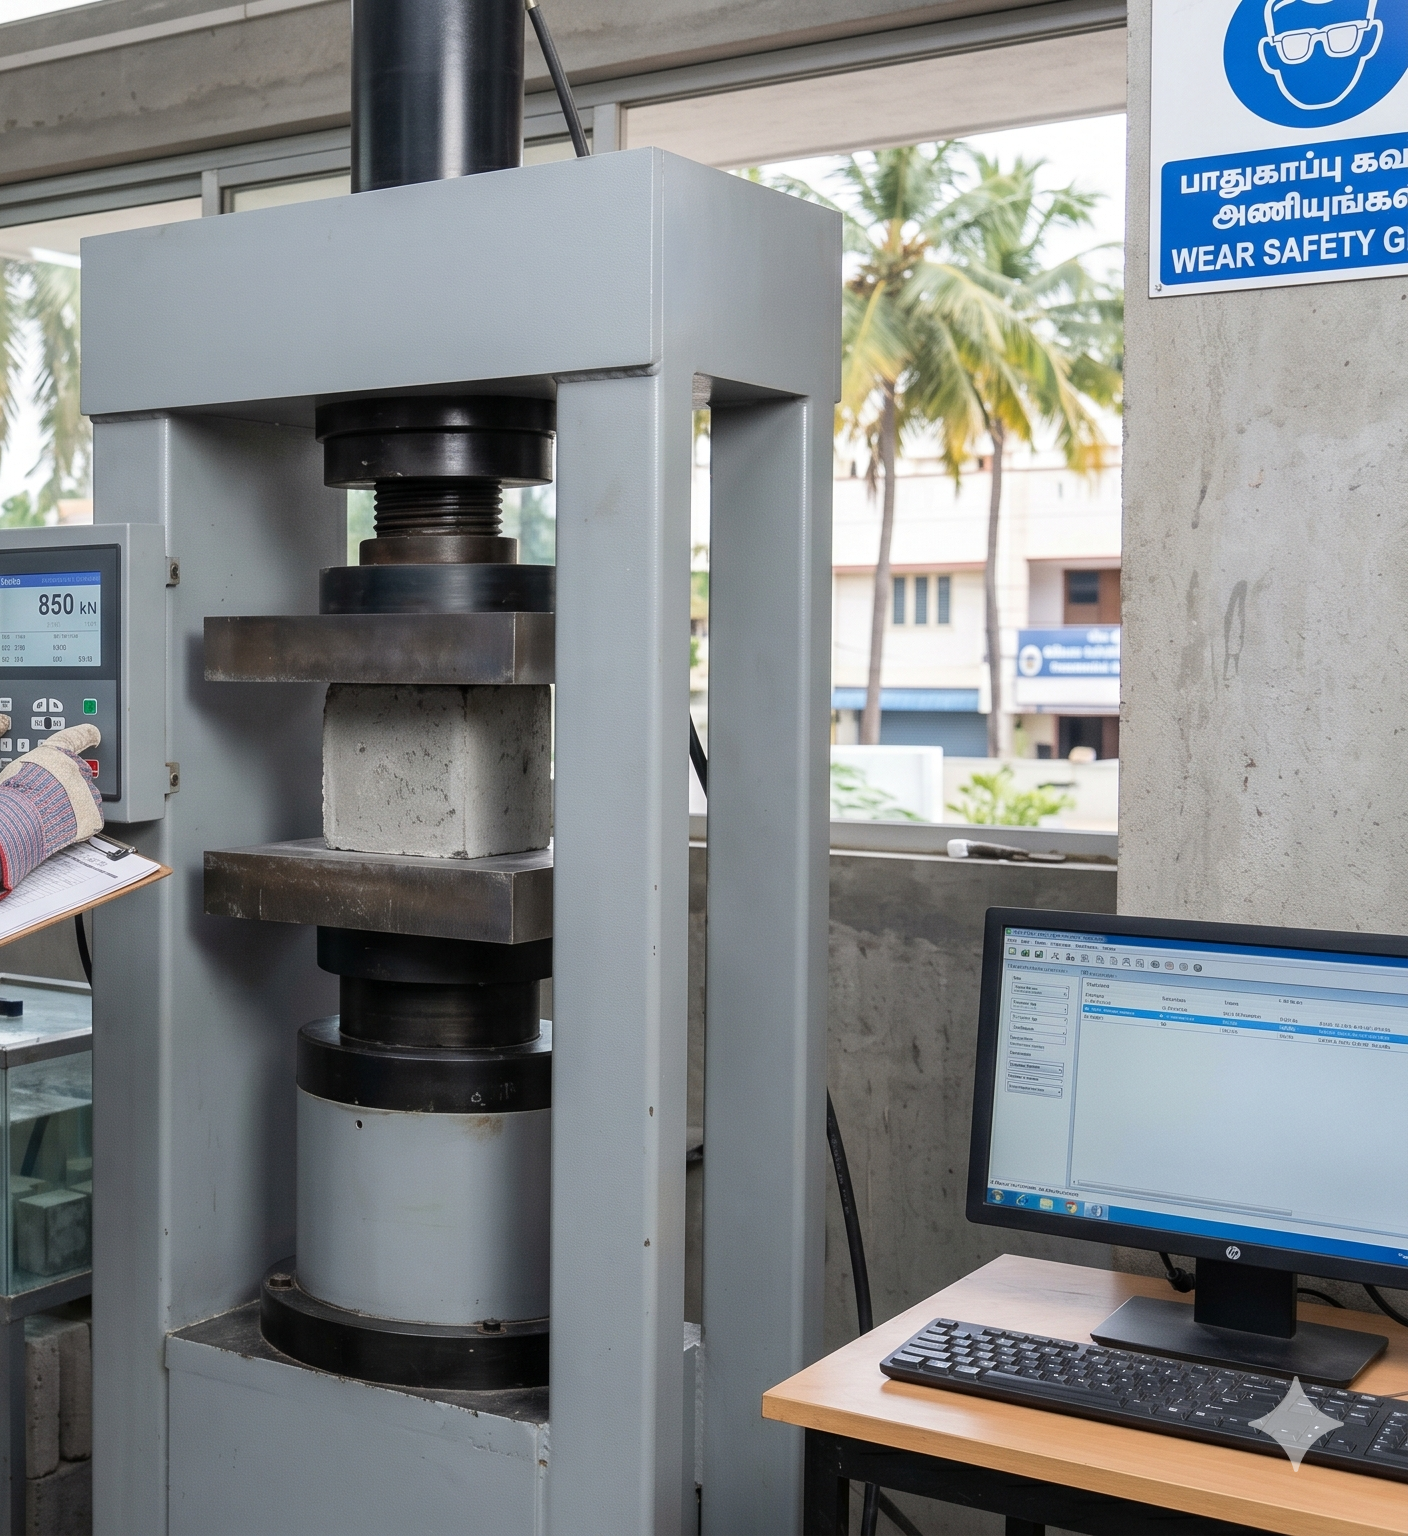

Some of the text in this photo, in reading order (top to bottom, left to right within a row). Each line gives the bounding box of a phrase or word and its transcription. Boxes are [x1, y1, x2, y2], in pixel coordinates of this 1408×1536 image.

[1180, 150, 1343, 199] பாதுகாப்பு
[1171, 225, 1408, 275] WEAR SAFETY G
[38, 592, 97, 616] 850 kN
